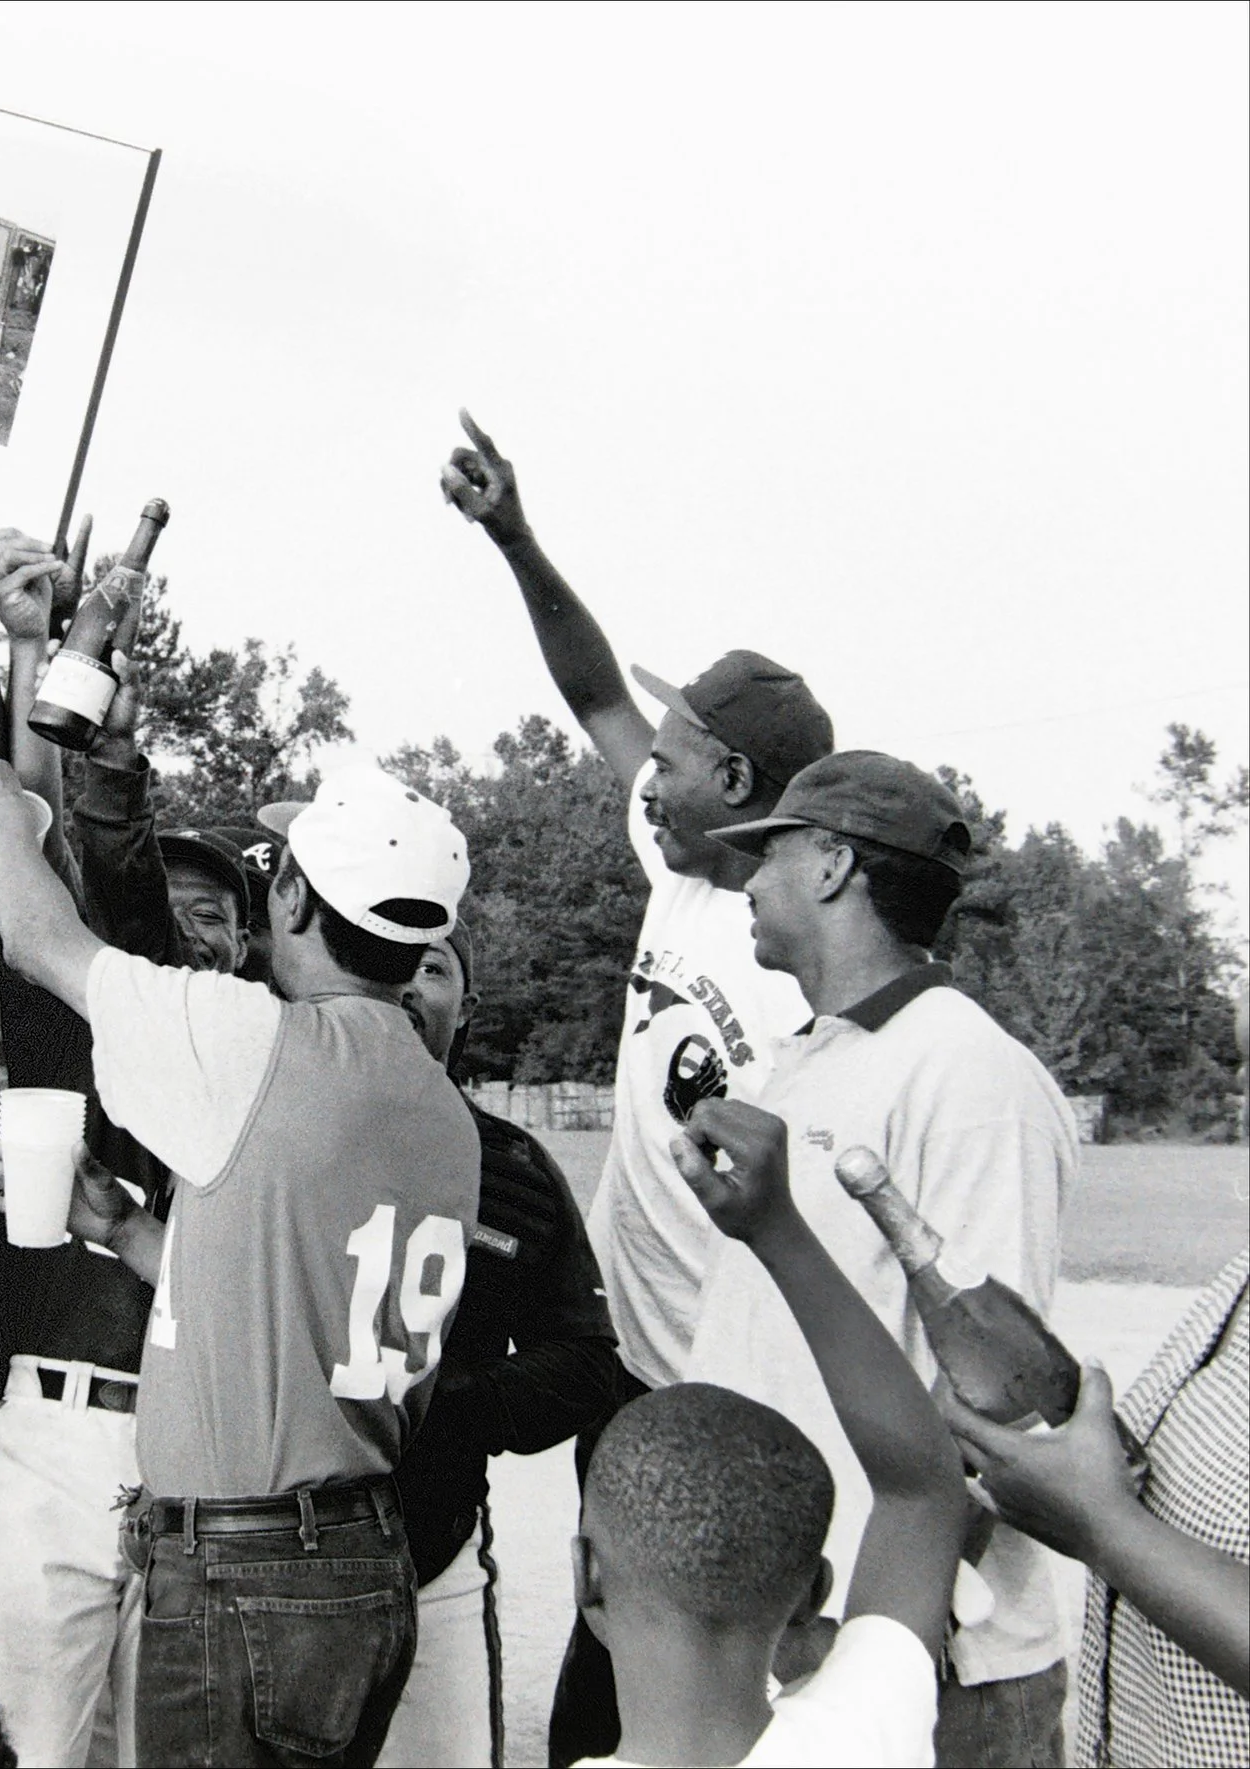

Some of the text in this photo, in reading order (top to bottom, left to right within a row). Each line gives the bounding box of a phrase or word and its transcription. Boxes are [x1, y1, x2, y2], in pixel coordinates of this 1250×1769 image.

[687, 975, 756, 1067] STARS
[474, 1230, 514, 1253] amond
[329, 1203, 467, 1405] 19
